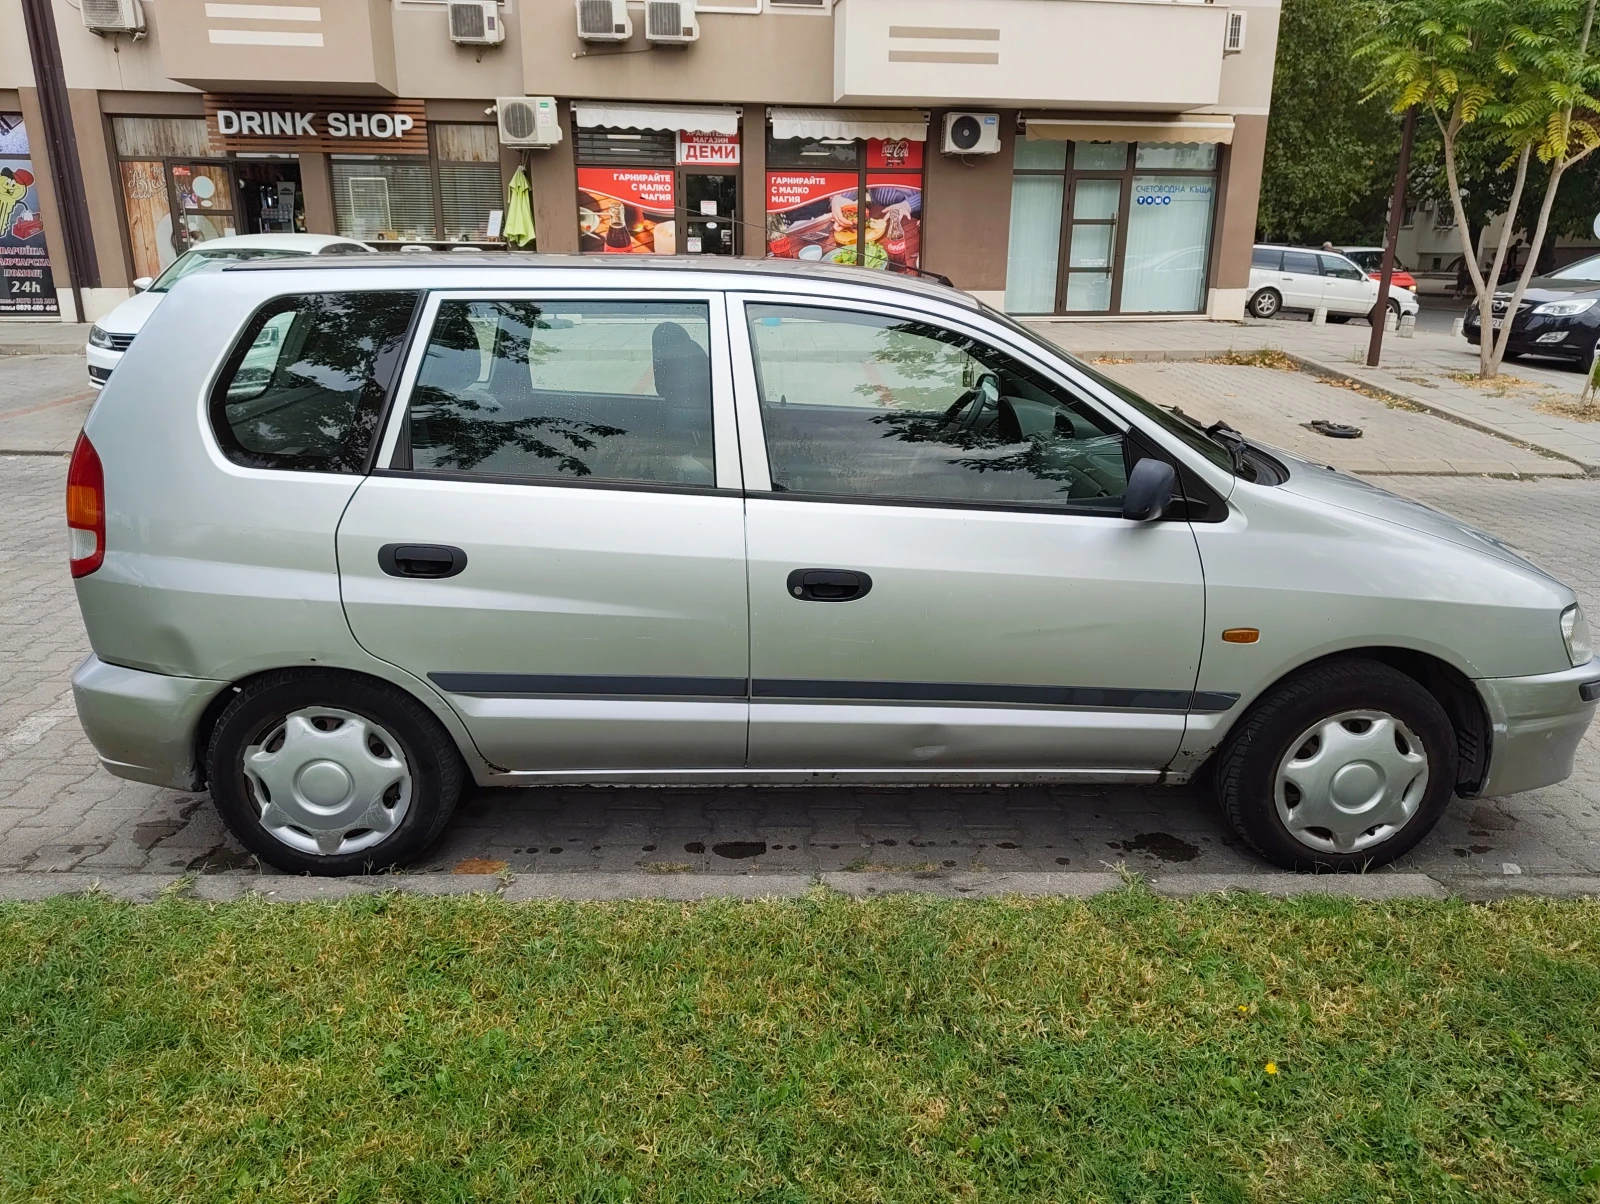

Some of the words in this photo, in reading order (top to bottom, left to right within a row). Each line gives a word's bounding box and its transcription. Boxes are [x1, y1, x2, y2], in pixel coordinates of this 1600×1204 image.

[217, 110, 318, 136] DRINK
[327, 112, 414, 138] SHOP
[685, 145, 736, 161] ДЕМИ
[613, 172, 671, 183] ГАРНИРАЙТЕ
[771, 176, 826, 185] ГАРНИРАЙТЕ
[631, 183, 638, 191] С
[639, 183, 671, 192] МАЛКО
[771, 186, 778, 194] С
[779, 186, 810, 195] МАЛКО
[1135, 185, 1185, 194] СЧЕТОВОДНА
[1189, 185, 1212, 194] КЪЩА
[641, 192, 671, 201] МАГИЯ
[771, 195, 800, 203] МАГИЯ
[4, 269, 43, 279] ПОМОЩ
[11, 281, 41, 293] 24h
